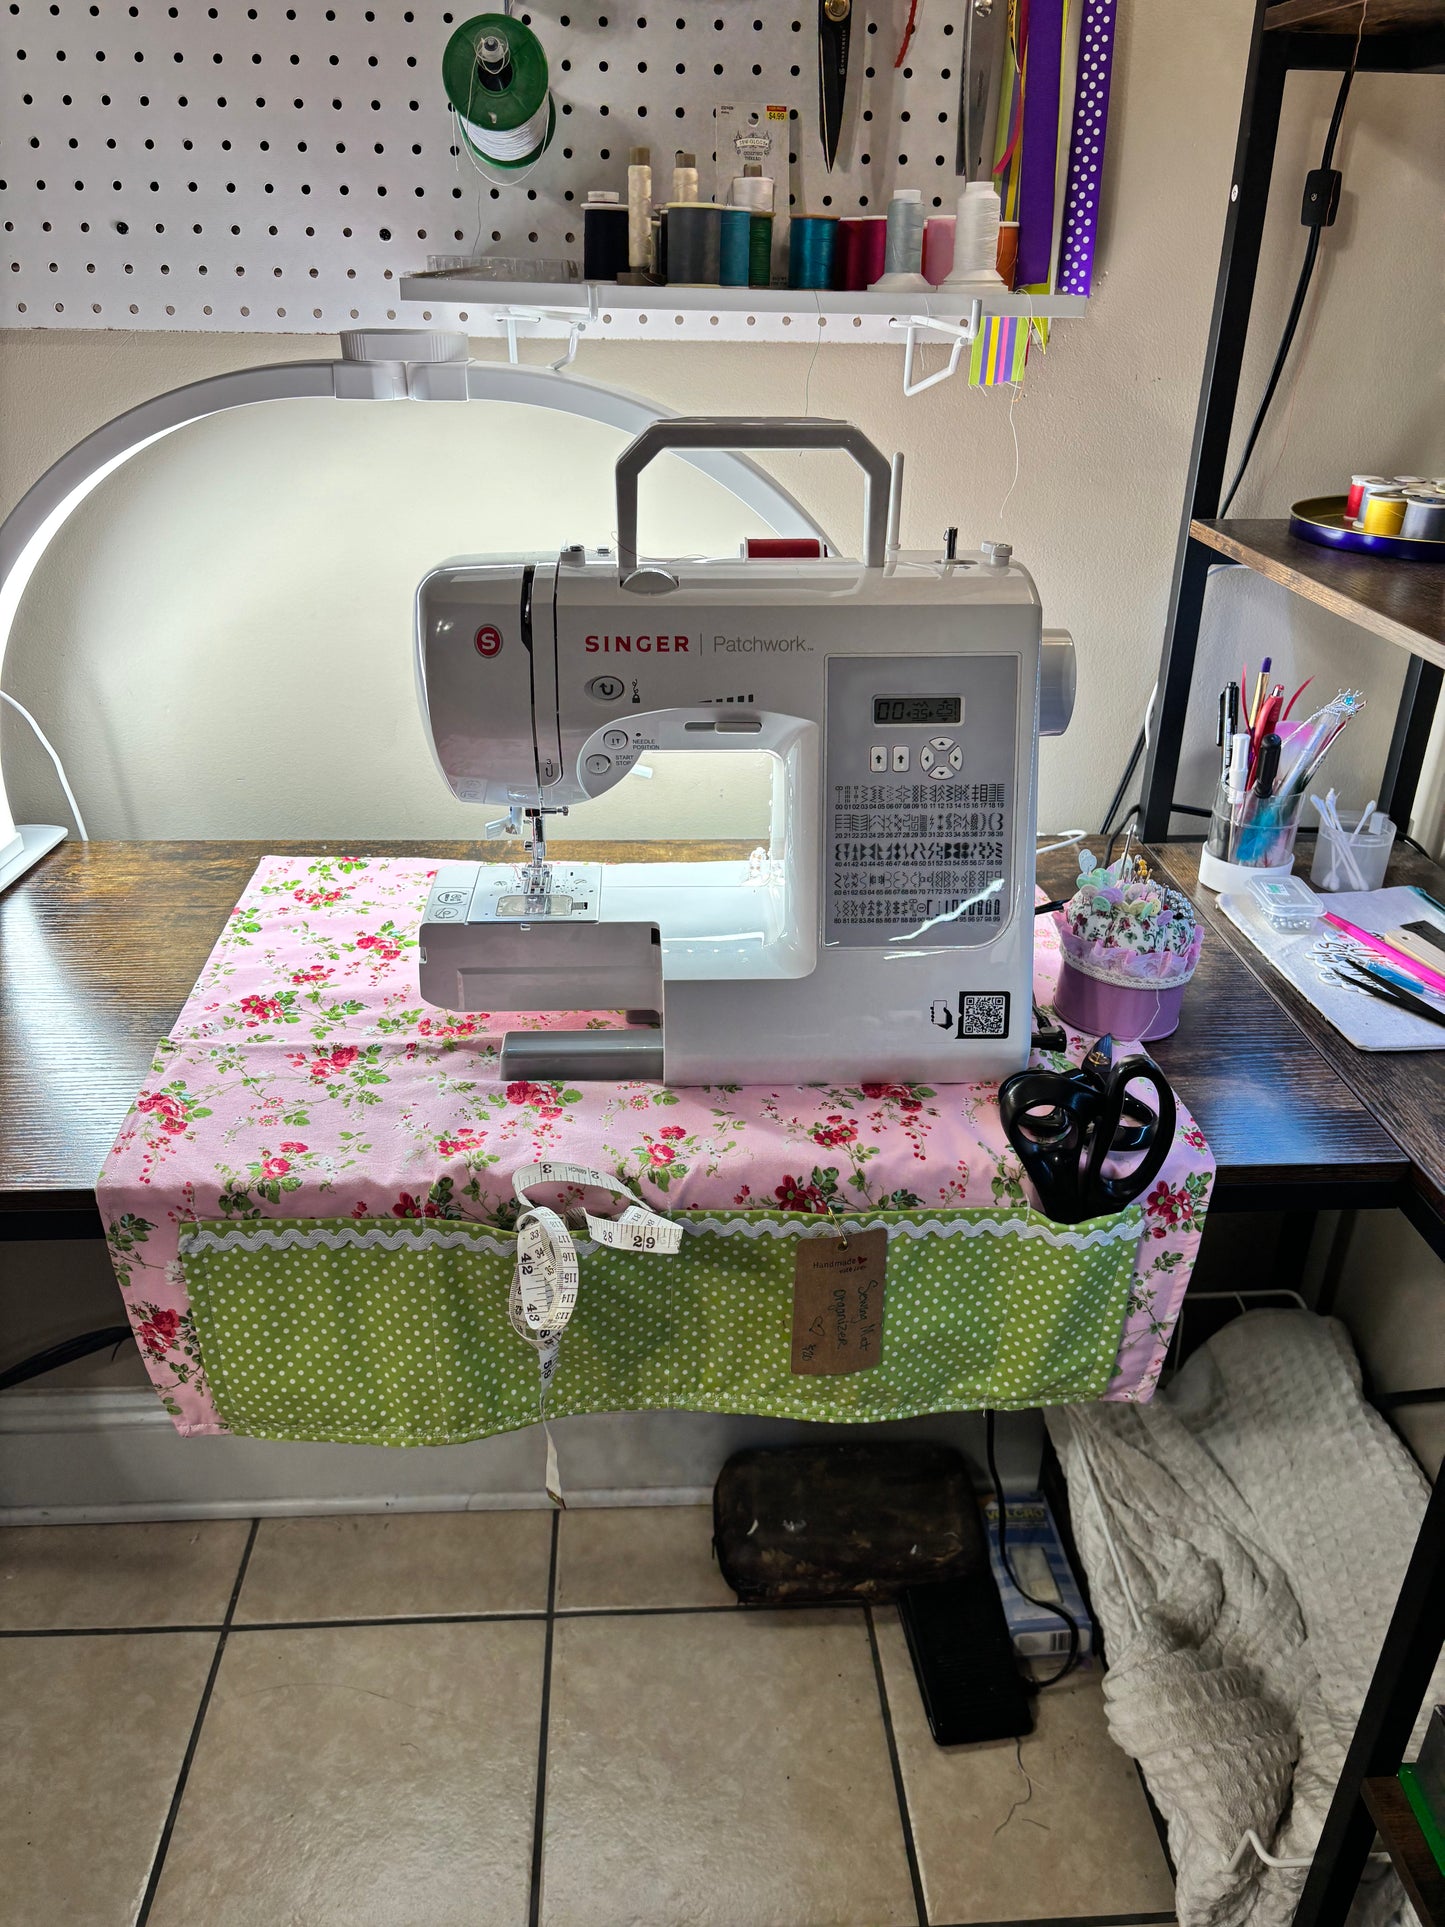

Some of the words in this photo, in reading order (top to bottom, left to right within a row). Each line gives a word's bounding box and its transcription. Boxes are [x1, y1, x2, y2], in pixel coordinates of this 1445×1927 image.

[768, 112, 784, 120] $4.99
[585, 636, 689, 653] SINGER
[878, 702, 904, 720] 00
[542, 1164, 552, 1174] 3
[590, 1170, 600, 1180] 2
[530, 1230, 539, 1240] 33
[557, 1235, 571, 1244] 117
[603, 1230, 613, 1244] 28
[633, 1236, 656, 1249] 29
[535, 1247, 545, 1259] 34
[562, 1252, 575, 1261] 116
[521, 1252, 534, 1276] 42
[813, 1258, 856, 1269] Handmade
[565, 1272, 577, 1283] 115
[562, 1294, 575, 1303] 114
[851, 1280, 878, 1324] Sewing
[526, 1303, 540, 1322] 43
[860, 1323, 876, 1351] Mat
[986, 1509, 1044, 1521] VLCRO
